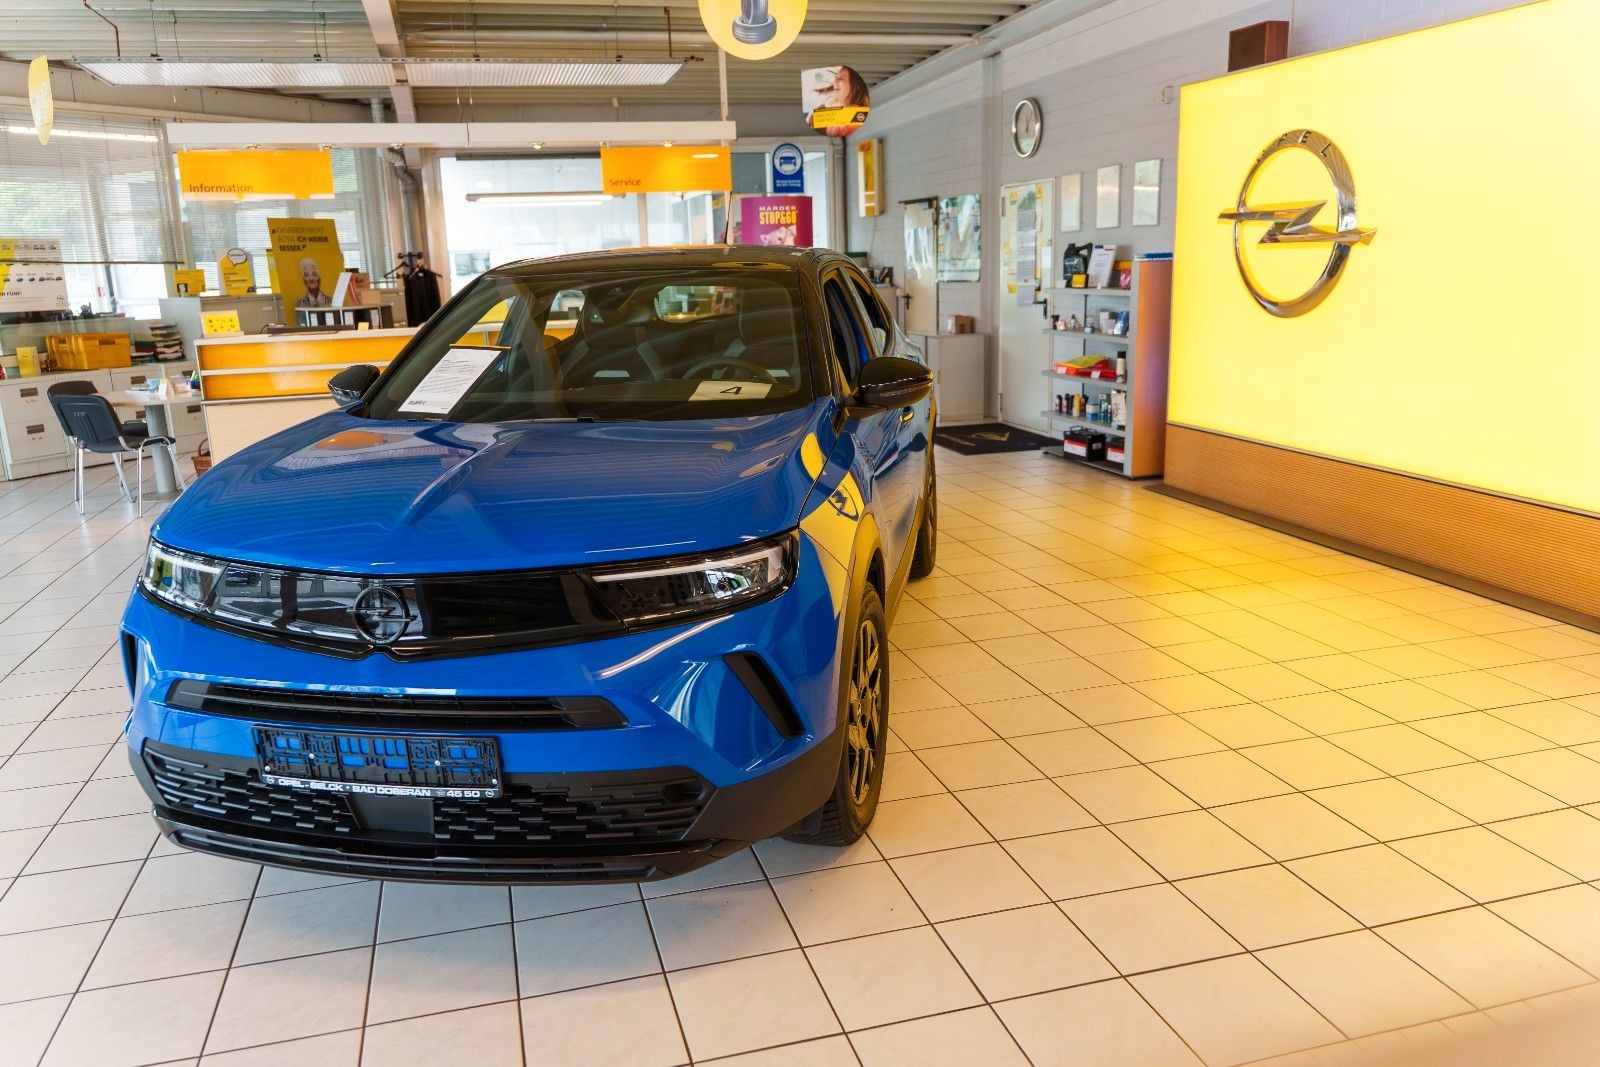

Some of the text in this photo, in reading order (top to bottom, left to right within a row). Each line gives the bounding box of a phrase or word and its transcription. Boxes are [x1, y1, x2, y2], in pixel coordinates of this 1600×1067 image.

[609, 178, 641, 186] Service
[189, 183, 253, 192] Information
[759, 211, 797, 225] STOP&GO
[720, 386, 742, 395] 4
[352, 785, 375, 794] BAD
[377, 786, 431, 797] DOBERAN
[446, 790, 462, 798] 45
[464, 790, 480, 798] 50
